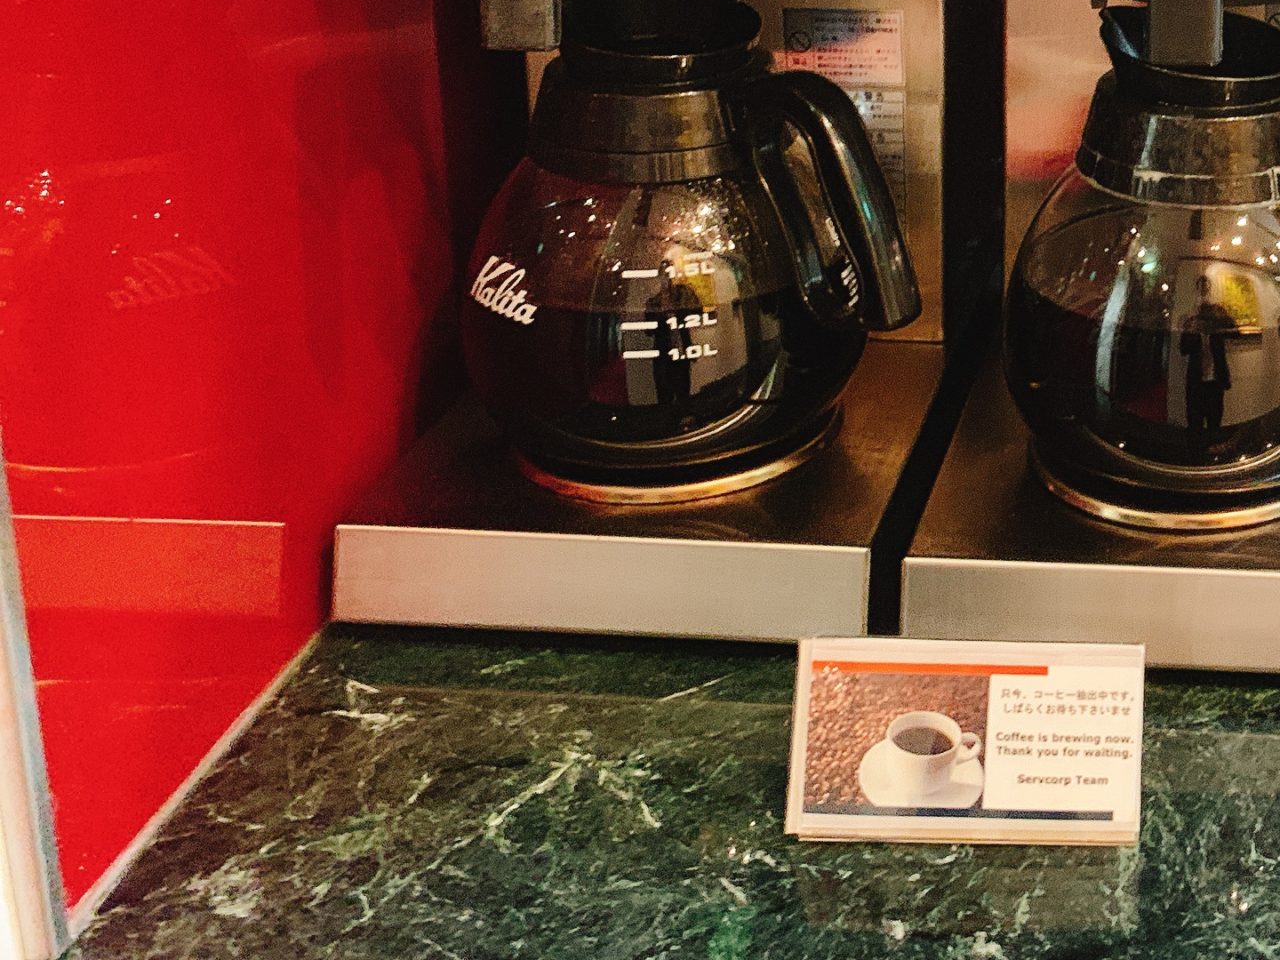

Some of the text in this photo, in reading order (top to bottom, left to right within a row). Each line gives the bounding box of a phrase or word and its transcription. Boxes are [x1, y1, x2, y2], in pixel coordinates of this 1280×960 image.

[664, 261, 716, 279] 1.5L
[470, 254, 538, 326] Kalita
[665, 311, 718, 330] 1.2L
[668, 343, 718, 361] 1.0L
[995, 731, 1135, 745] Coffee is brewing now.
[996, 745, 1134, 760] Thank you for waiting.
[1017, 773, 1109, 786] Servcorp Team
